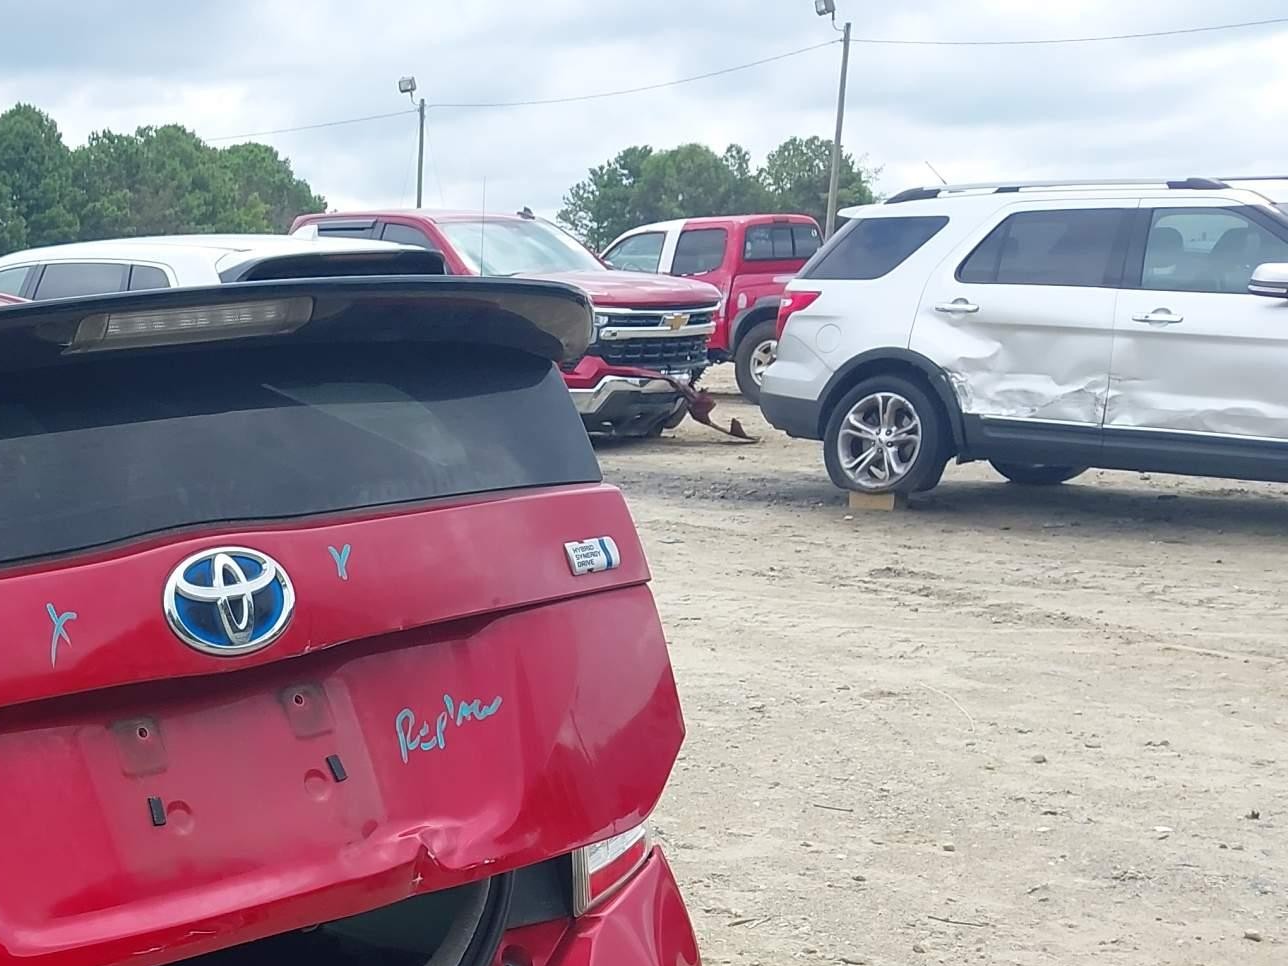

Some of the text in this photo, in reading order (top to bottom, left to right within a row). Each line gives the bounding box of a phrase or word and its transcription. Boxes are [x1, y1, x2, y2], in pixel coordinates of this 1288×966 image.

[572, 544, 595, 554] HYBRID
[575, 550, 601, 561] SYNERGY
[577, 559, 595, 568] DRIVE
